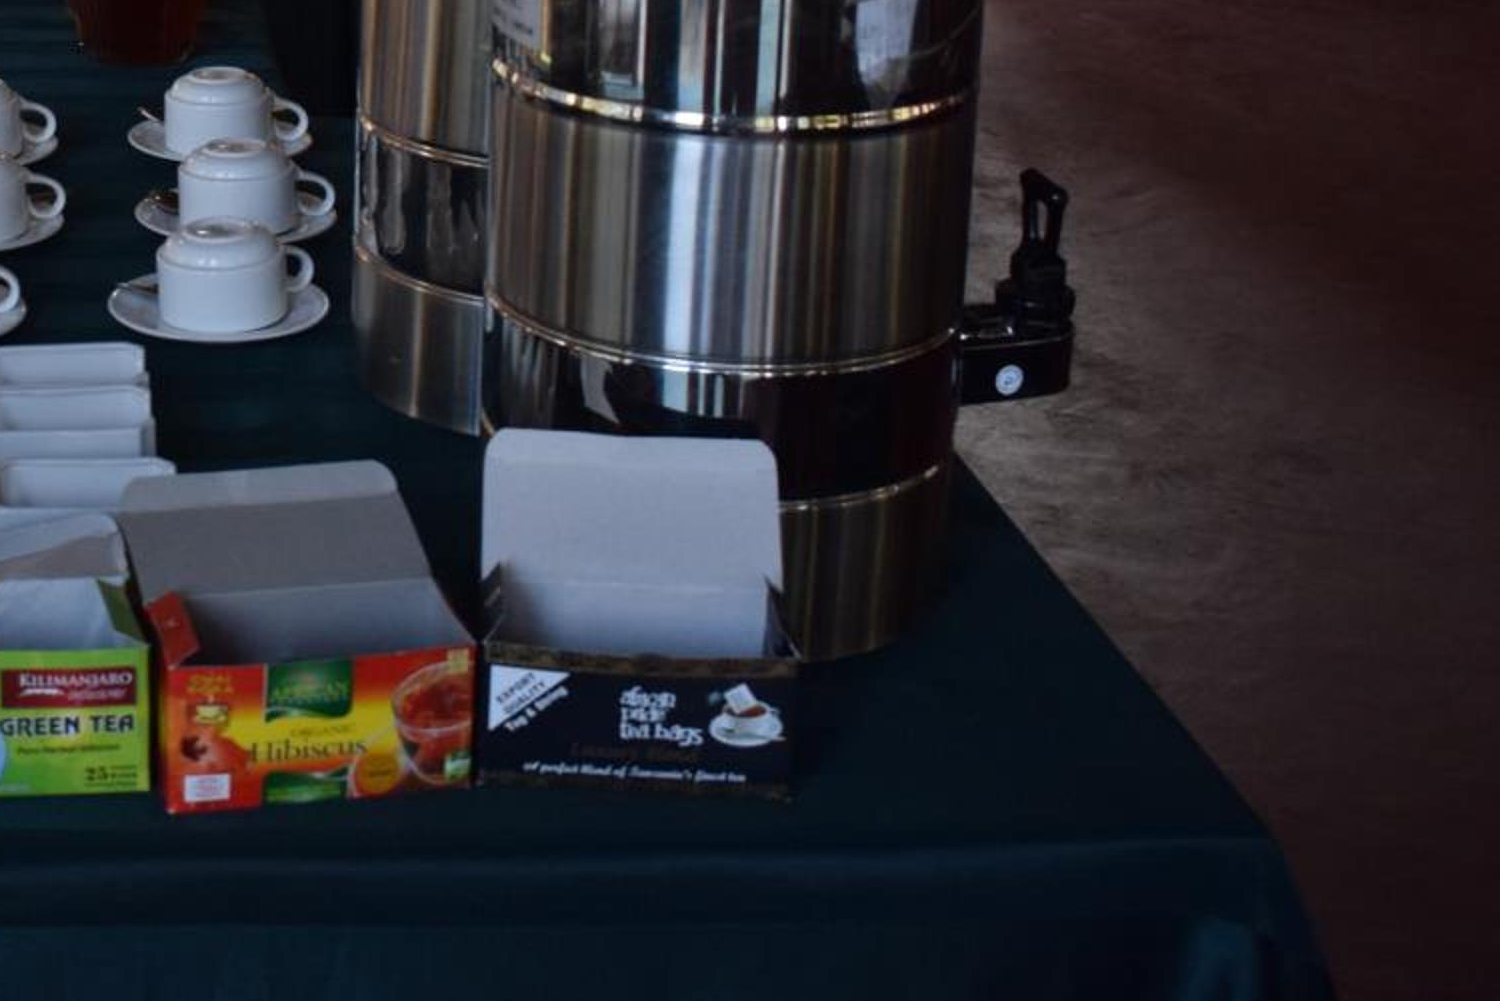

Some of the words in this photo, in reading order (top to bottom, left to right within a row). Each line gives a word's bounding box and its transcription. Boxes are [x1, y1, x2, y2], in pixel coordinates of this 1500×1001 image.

[18, 671, 133, 689] KILIMANJARO
[89, 713, 135, 734] TEA
[250, 739, 367, 764] Hibiscus
